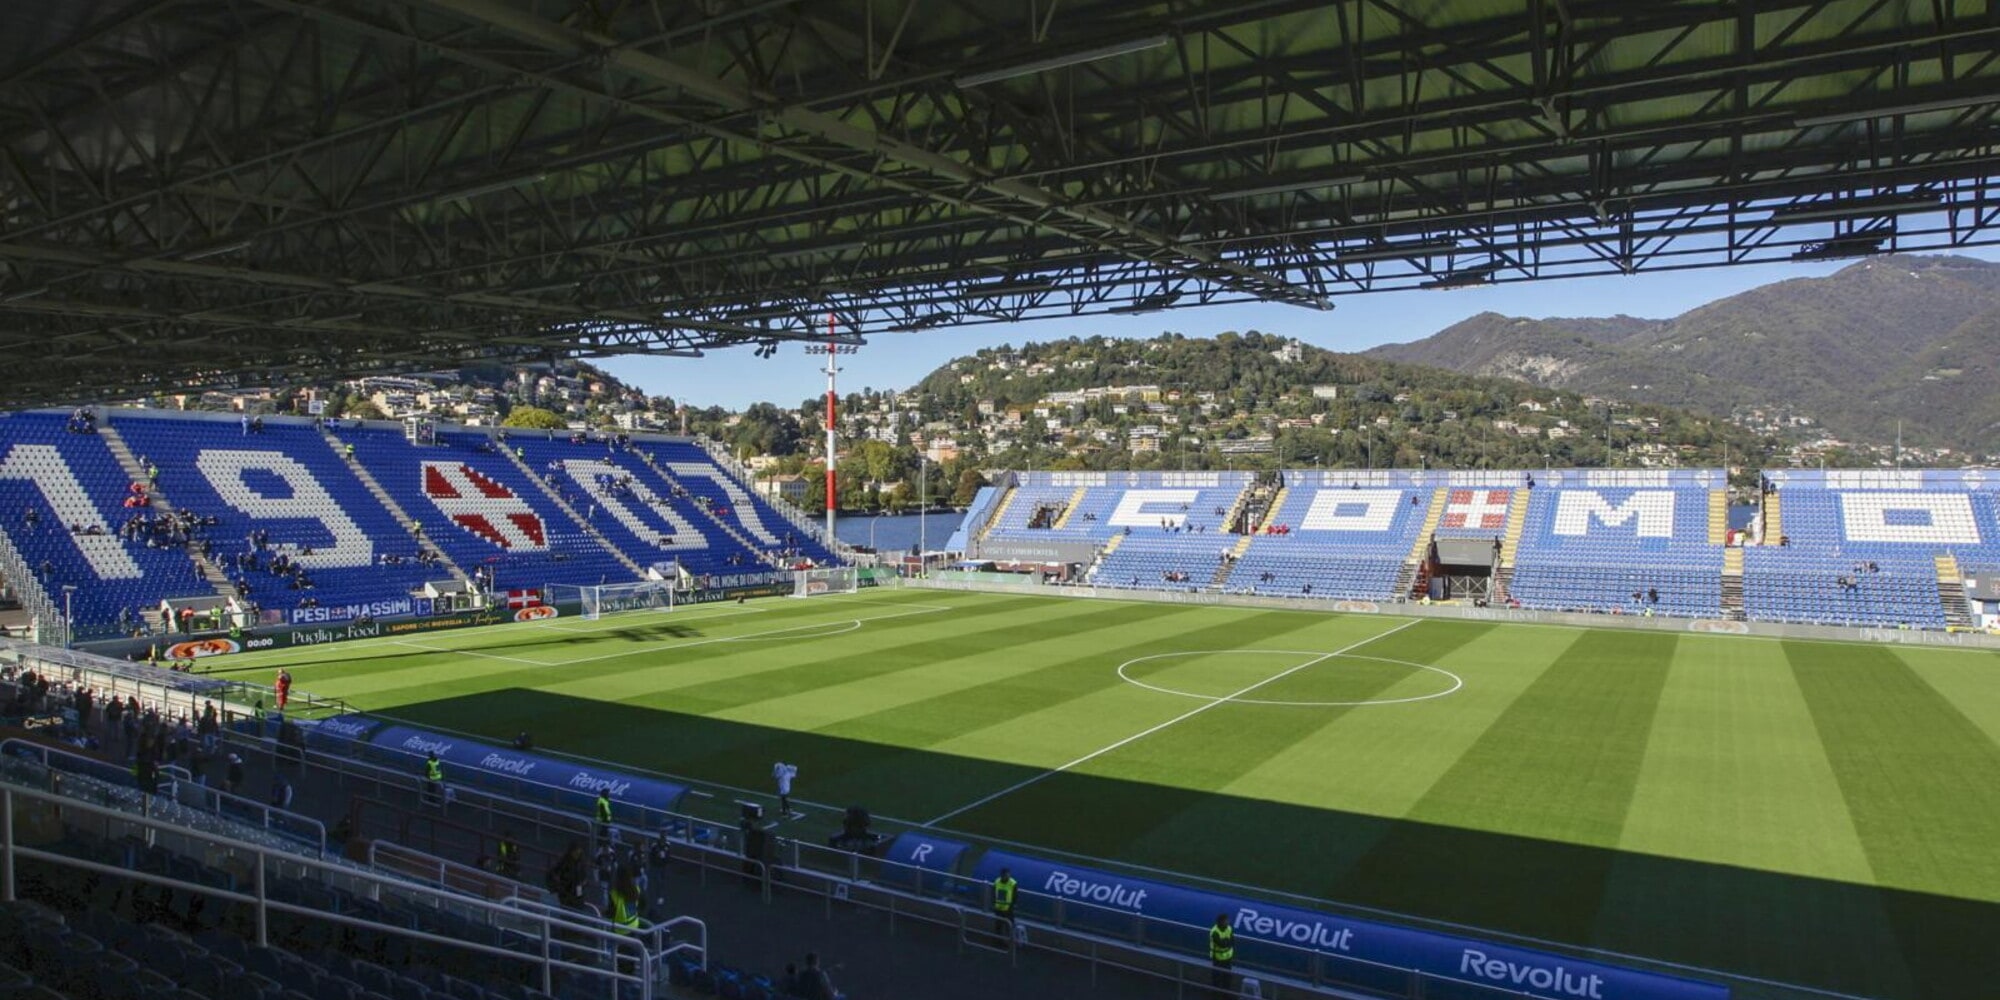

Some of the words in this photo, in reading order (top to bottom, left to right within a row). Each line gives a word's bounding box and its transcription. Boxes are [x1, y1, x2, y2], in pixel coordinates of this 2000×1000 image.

[293, 607, 330, 623] PESI
[346, 601, 411, 619] MASSIMI
[247, 638, 273, 648] 00:00
[291, 628, 333, 644] Puglia
[347, 622, 380, 638] Food
[319, 717, 365, 736] Revolut
[402, 736, 453, 755] Revolut
[480, 752, 537, 775] Revolut
[569, 771, 632, 796] Revolut
[911, 843, 934, 862] R
[1044, 871, 1148, 909] Revolut
[1233, 907, 1355, 951] Revolut
[1460, 948, 1604, 1000] Revolut
